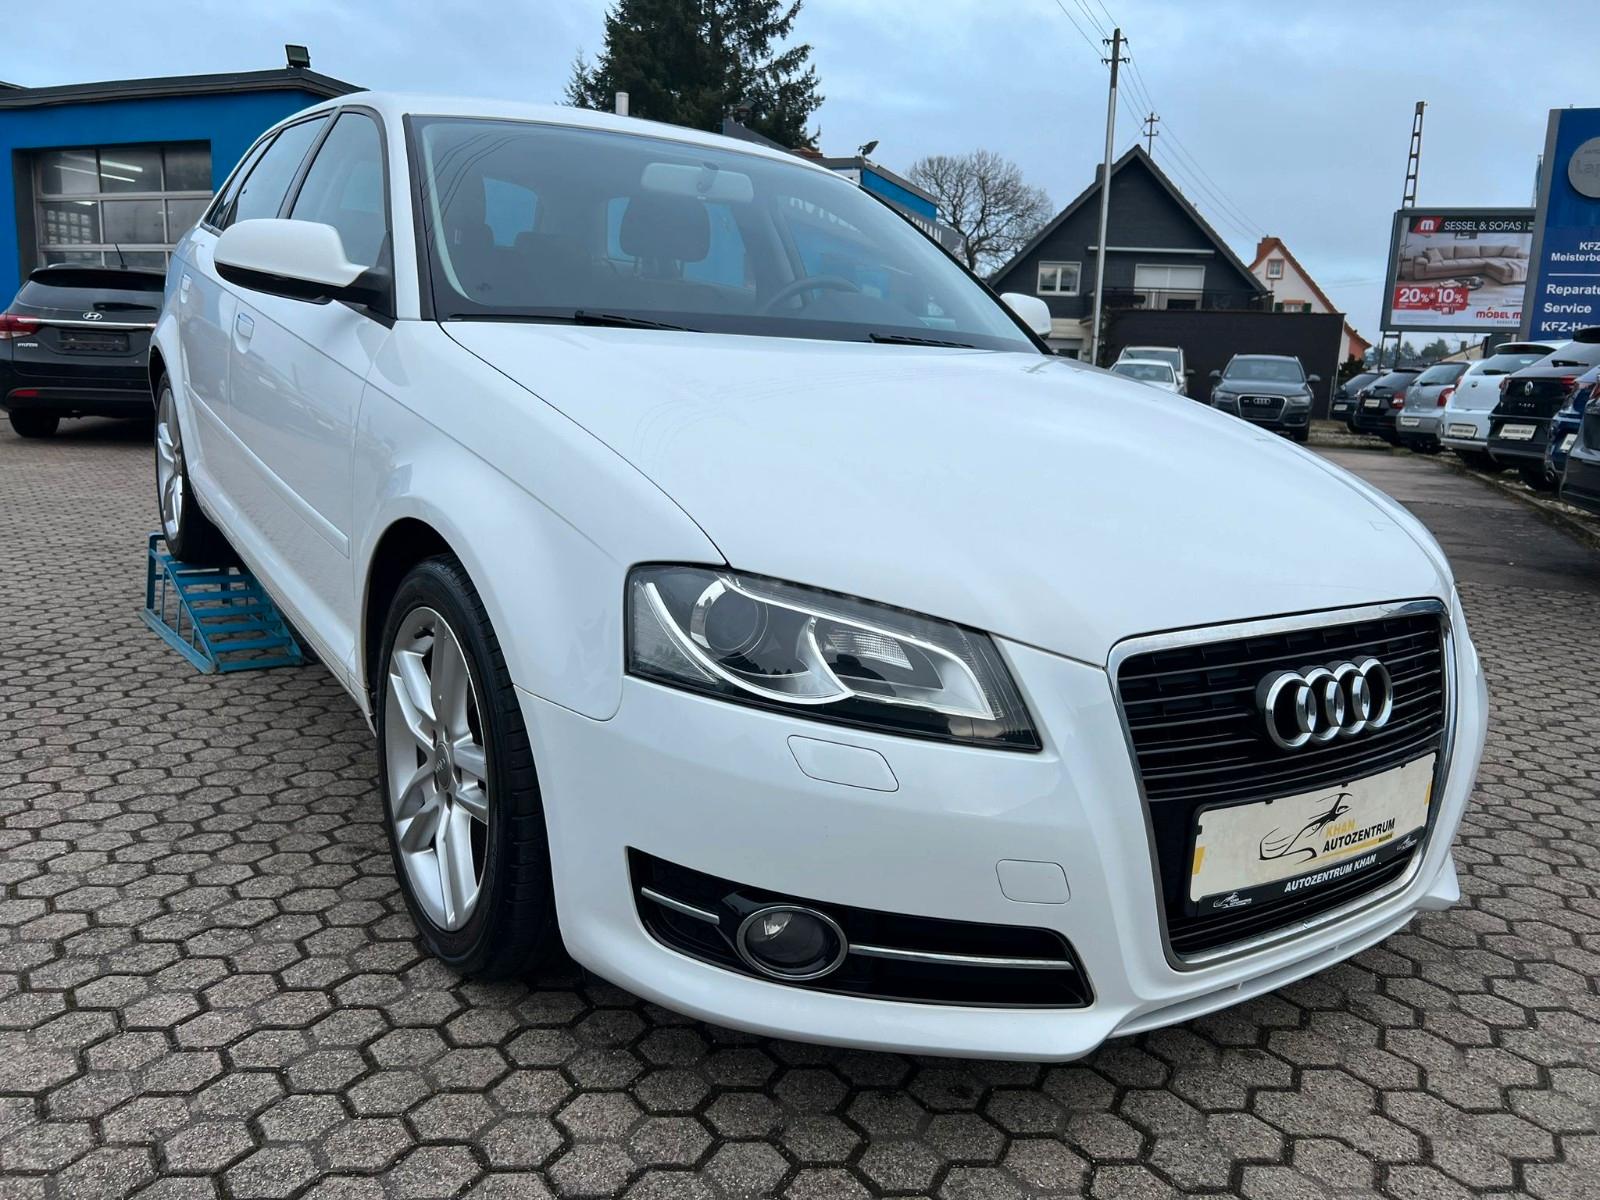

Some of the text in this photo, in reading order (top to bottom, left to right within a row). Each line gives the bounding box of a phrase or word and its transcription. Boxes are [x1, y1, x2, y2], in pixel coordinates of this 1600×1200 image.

[1444, 221, 1522, 231] SESSEL & SOFAS
[1399, 288, 1464, 304] 20% 10%
[1543, 302, 1592, 313] Service
[1323, 817, 1396, 853] AUTOZENTRUM
[1325, 818, 1356, 838] KHAN
[1284, 853, 1377, 893] AUTOZENTRUM KHAN
